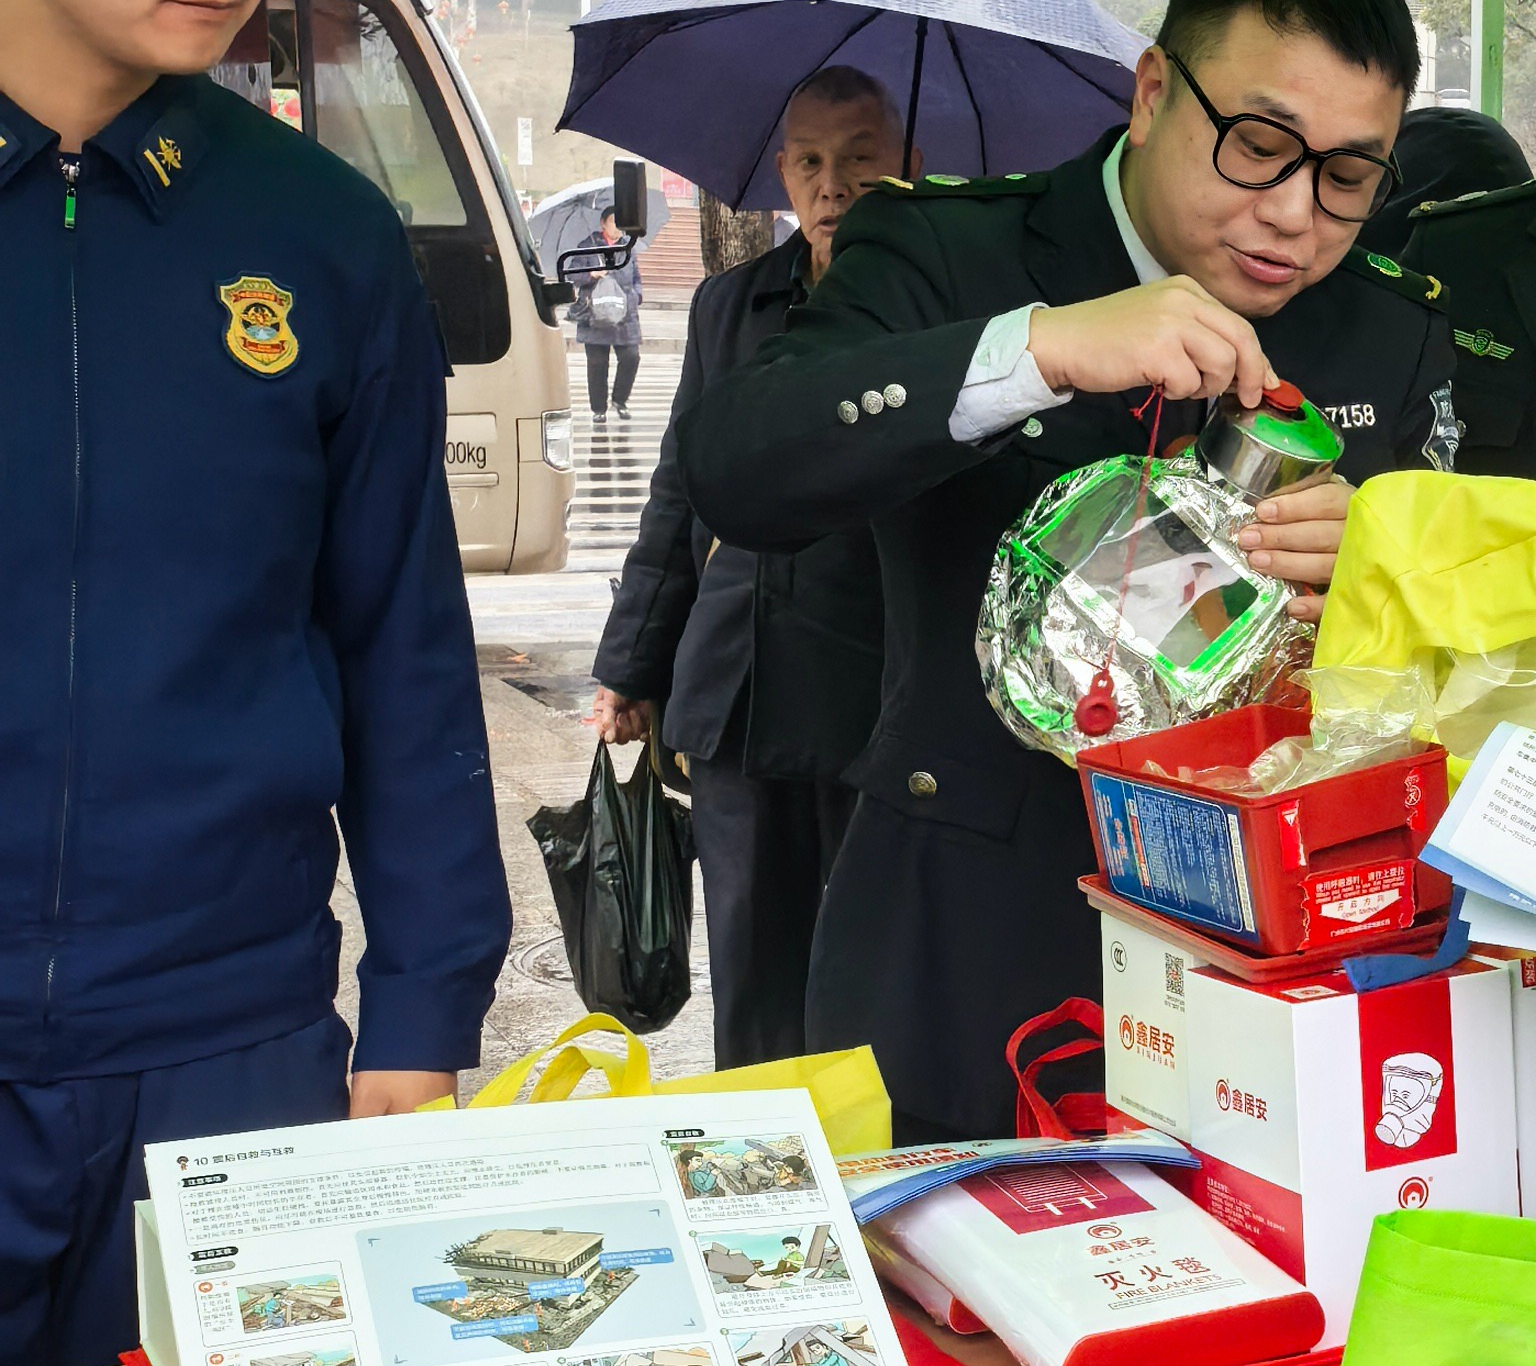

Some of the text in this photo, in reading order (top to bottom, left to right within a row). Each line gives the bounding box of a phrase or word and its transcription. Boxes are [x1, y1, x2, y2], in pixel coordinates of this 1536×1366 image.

[1136, 1021, 1175, 1058] 鑫居安
[1232, 1089, 1267, 1122] 鑫居安
[1094, 1257, 1211, 1291] 灭火毯
[1115, 1288, 1146, 1300] FIRE
[1149, 1273, 1223, 1293] BLANKETS
